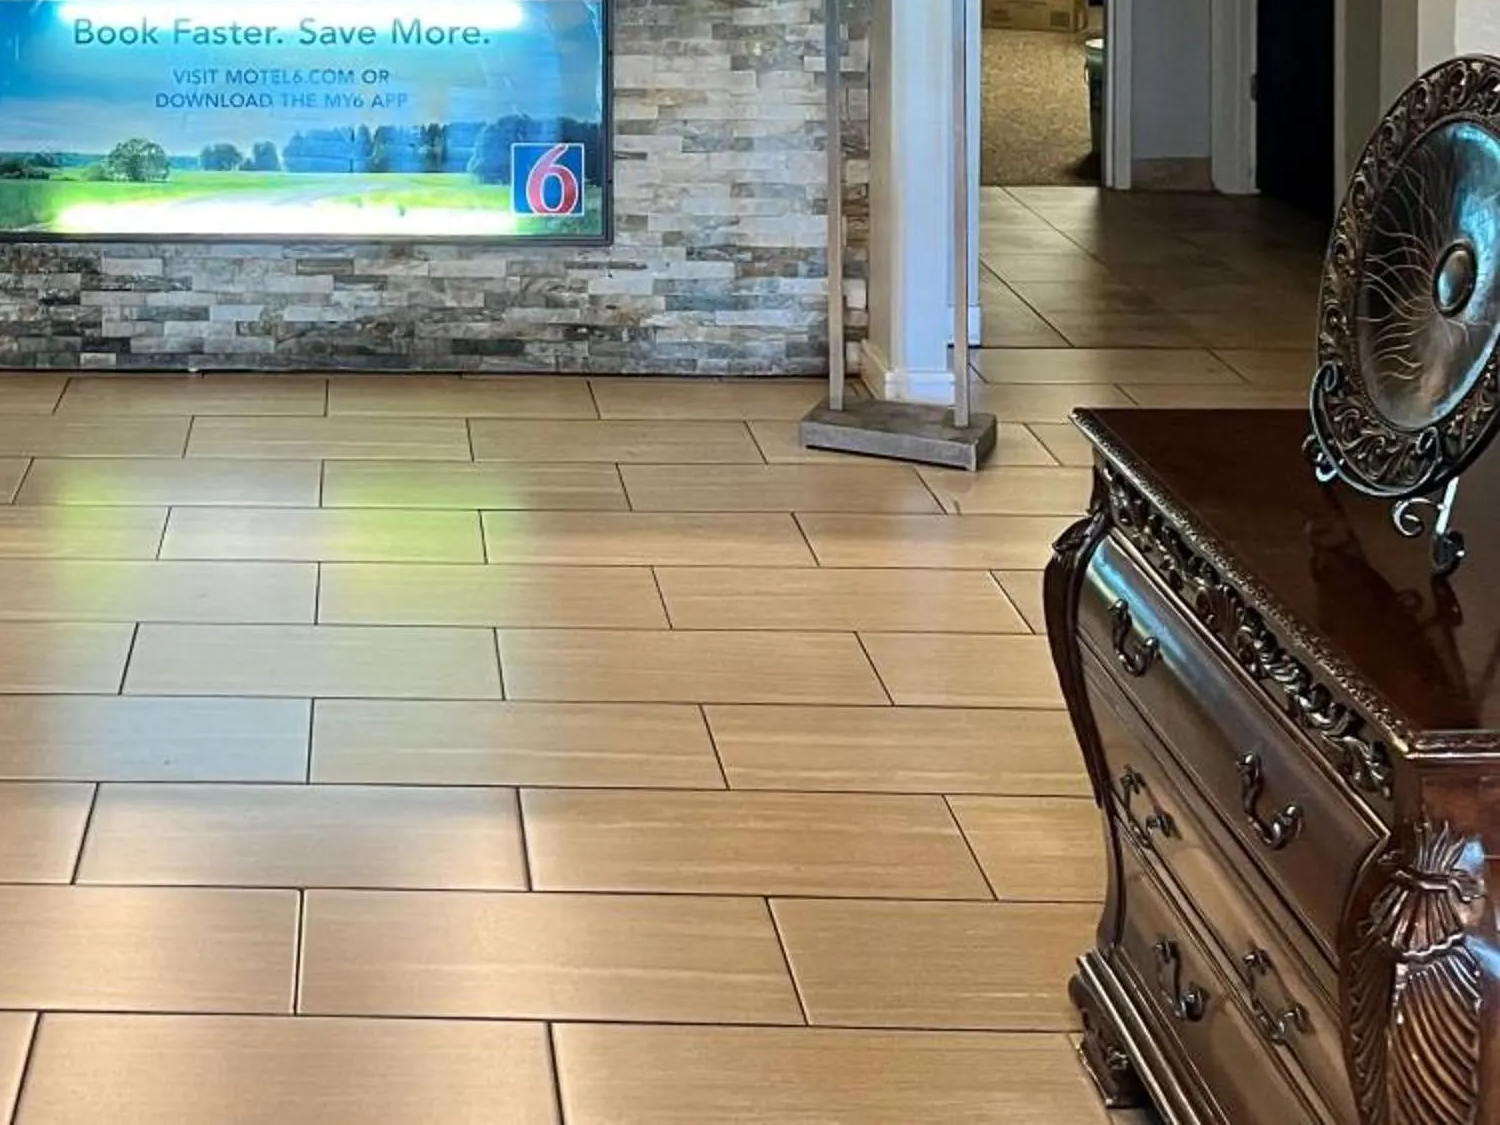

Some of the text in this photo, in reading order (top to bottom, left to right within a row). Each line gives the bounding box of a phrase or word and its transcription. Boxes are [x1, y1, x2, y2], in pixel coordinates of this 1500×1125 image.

[73, 17, 491, 45] Book Faster. Save More.
[173, 68, 390, 85] VISIT MOTEL6.COM OR
[155, 93, 409, 109] DOWNLOAD THE MY6 APP
[526, 143, 579, 215] 6
